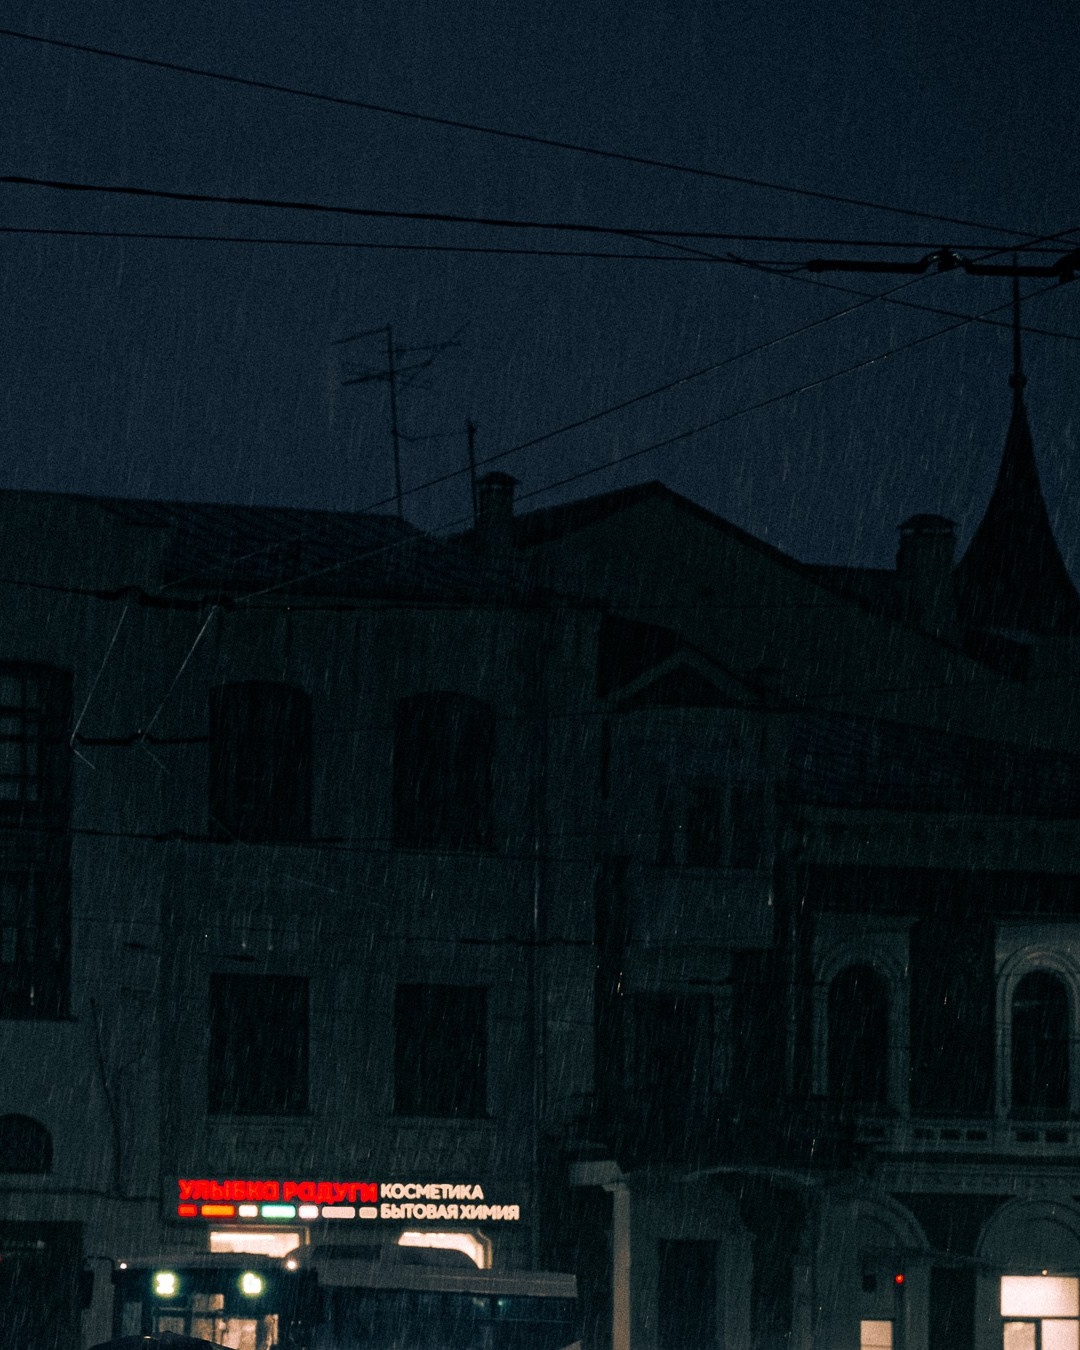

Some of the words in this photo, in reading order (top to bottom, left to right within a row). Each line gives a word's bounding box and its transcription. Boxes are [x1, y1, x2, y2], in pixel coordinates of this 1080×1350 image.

[380, 1183, 484, 1200] КОСМЕТИКА
[380, 1203, 458, 1219] БЫТОВАЯ
[460, 1204, 520, 1220] ХИМИЯ
